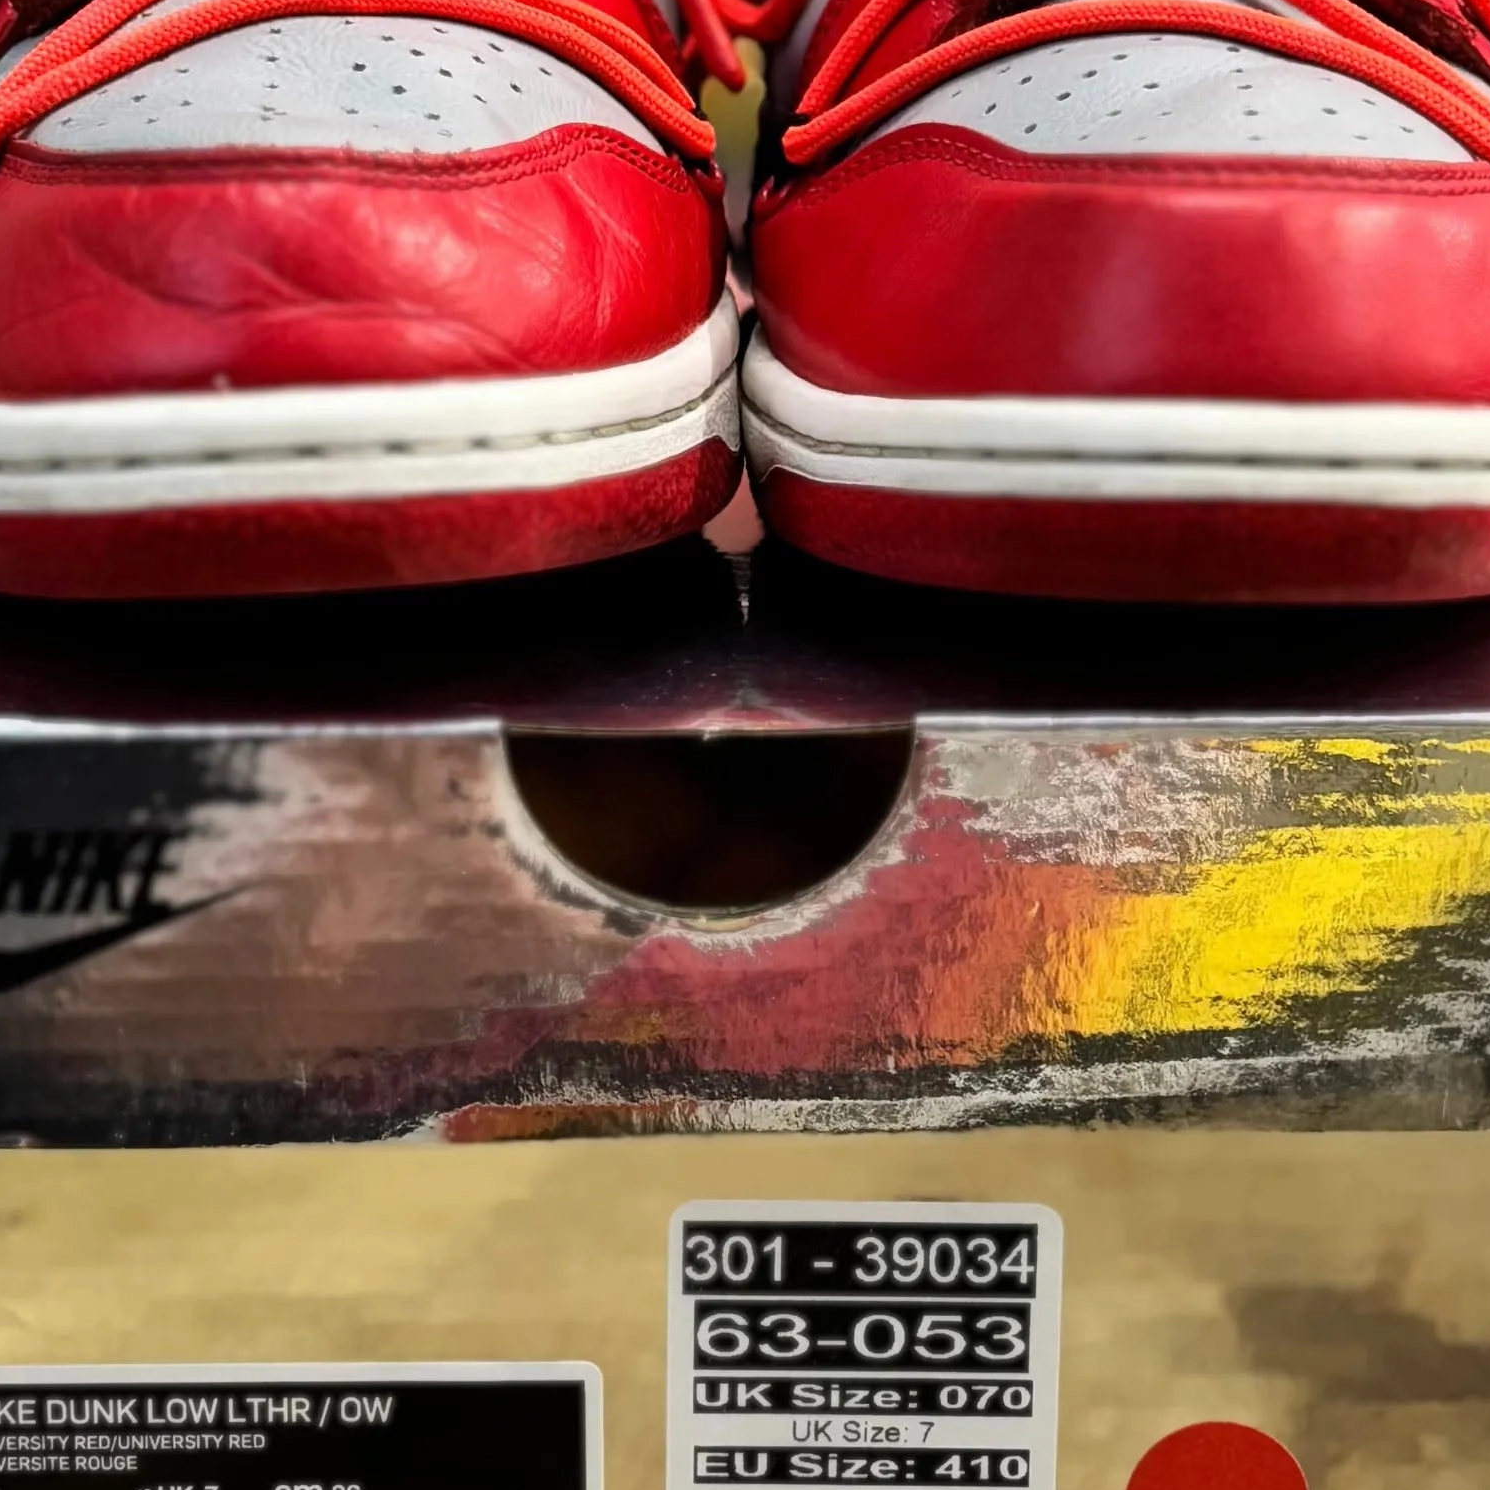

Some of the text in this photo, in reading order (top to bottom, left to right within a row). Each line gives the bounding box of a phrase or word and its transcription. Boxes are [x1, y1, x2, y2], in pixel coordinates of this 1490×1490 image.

[684, 1235, 782, 1281] 301
[855, 1237, 1035, 1284] 39034
[697, 1313, 1025, 1360] 63-053
[696, 1383, 1031, 1409] UK Size: 070
[47, 1399, 137, 1424] DUNK
[148, 1398, 218, 1423] LOW
[229, 1398, 310, 1422] LTHR
[319, 1397, 330, 1427] /
[341, 1397, 392, 1422] OW
[75, 1434, 223, 1452] RED/UNIVERSITY
[229, 1434, 265, 1448] RED
[793, 1421, 934, 1442] UK Size: 7
[76, 1456, 137, 1470] ROUGE
[697, 1452, 1028, 1479] EU Size: 410
